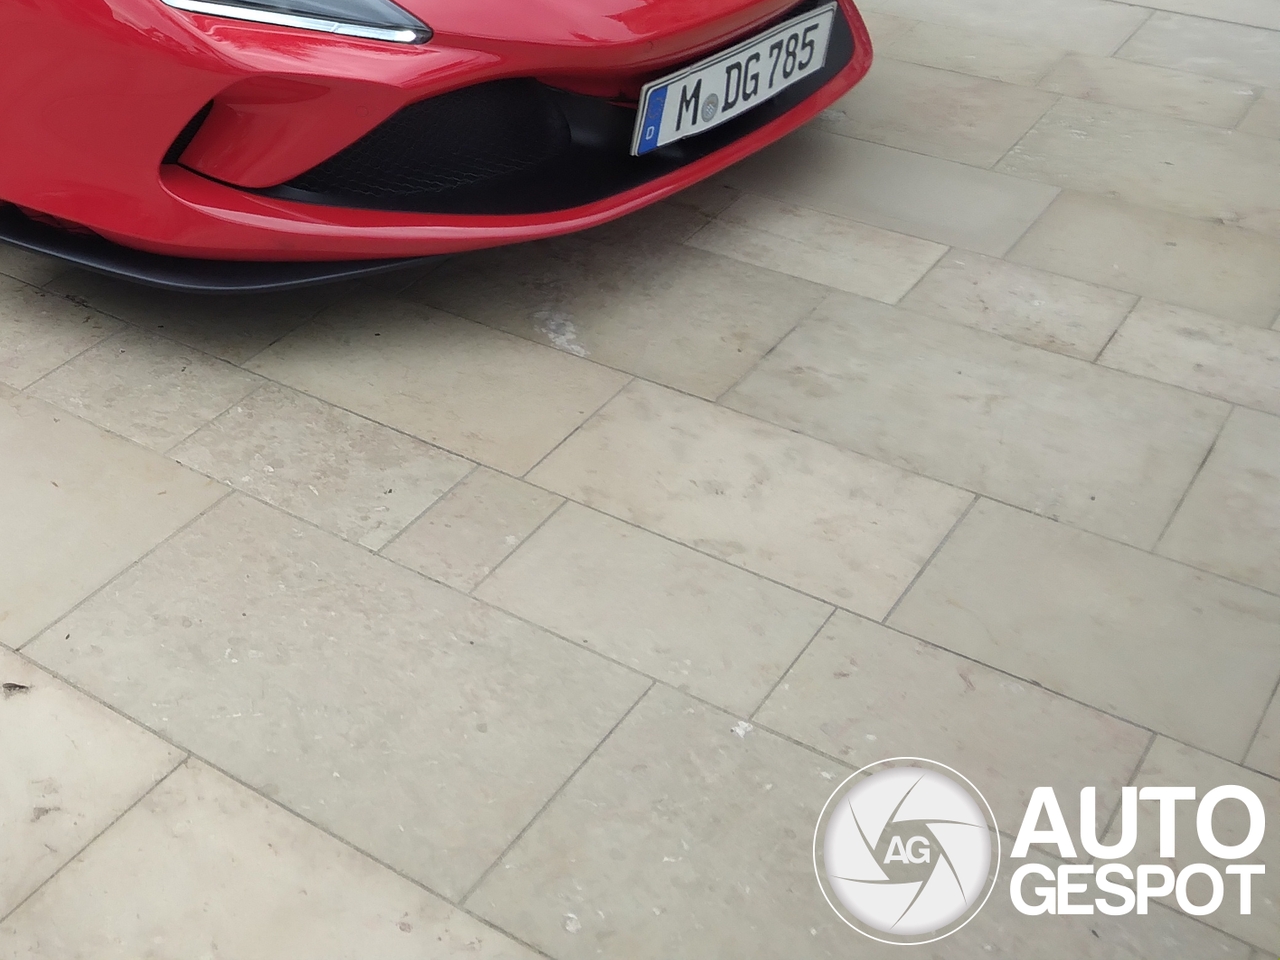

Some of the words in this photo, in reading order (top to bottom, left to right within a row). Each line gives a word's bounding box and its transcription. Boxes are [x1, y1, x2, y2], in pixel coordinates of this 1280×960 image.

[645, 126, 654, 140] D
[675, 78, 702, 132] M
[722, 51, 761, 113] DG
[768, 23, 820, 89] 785
